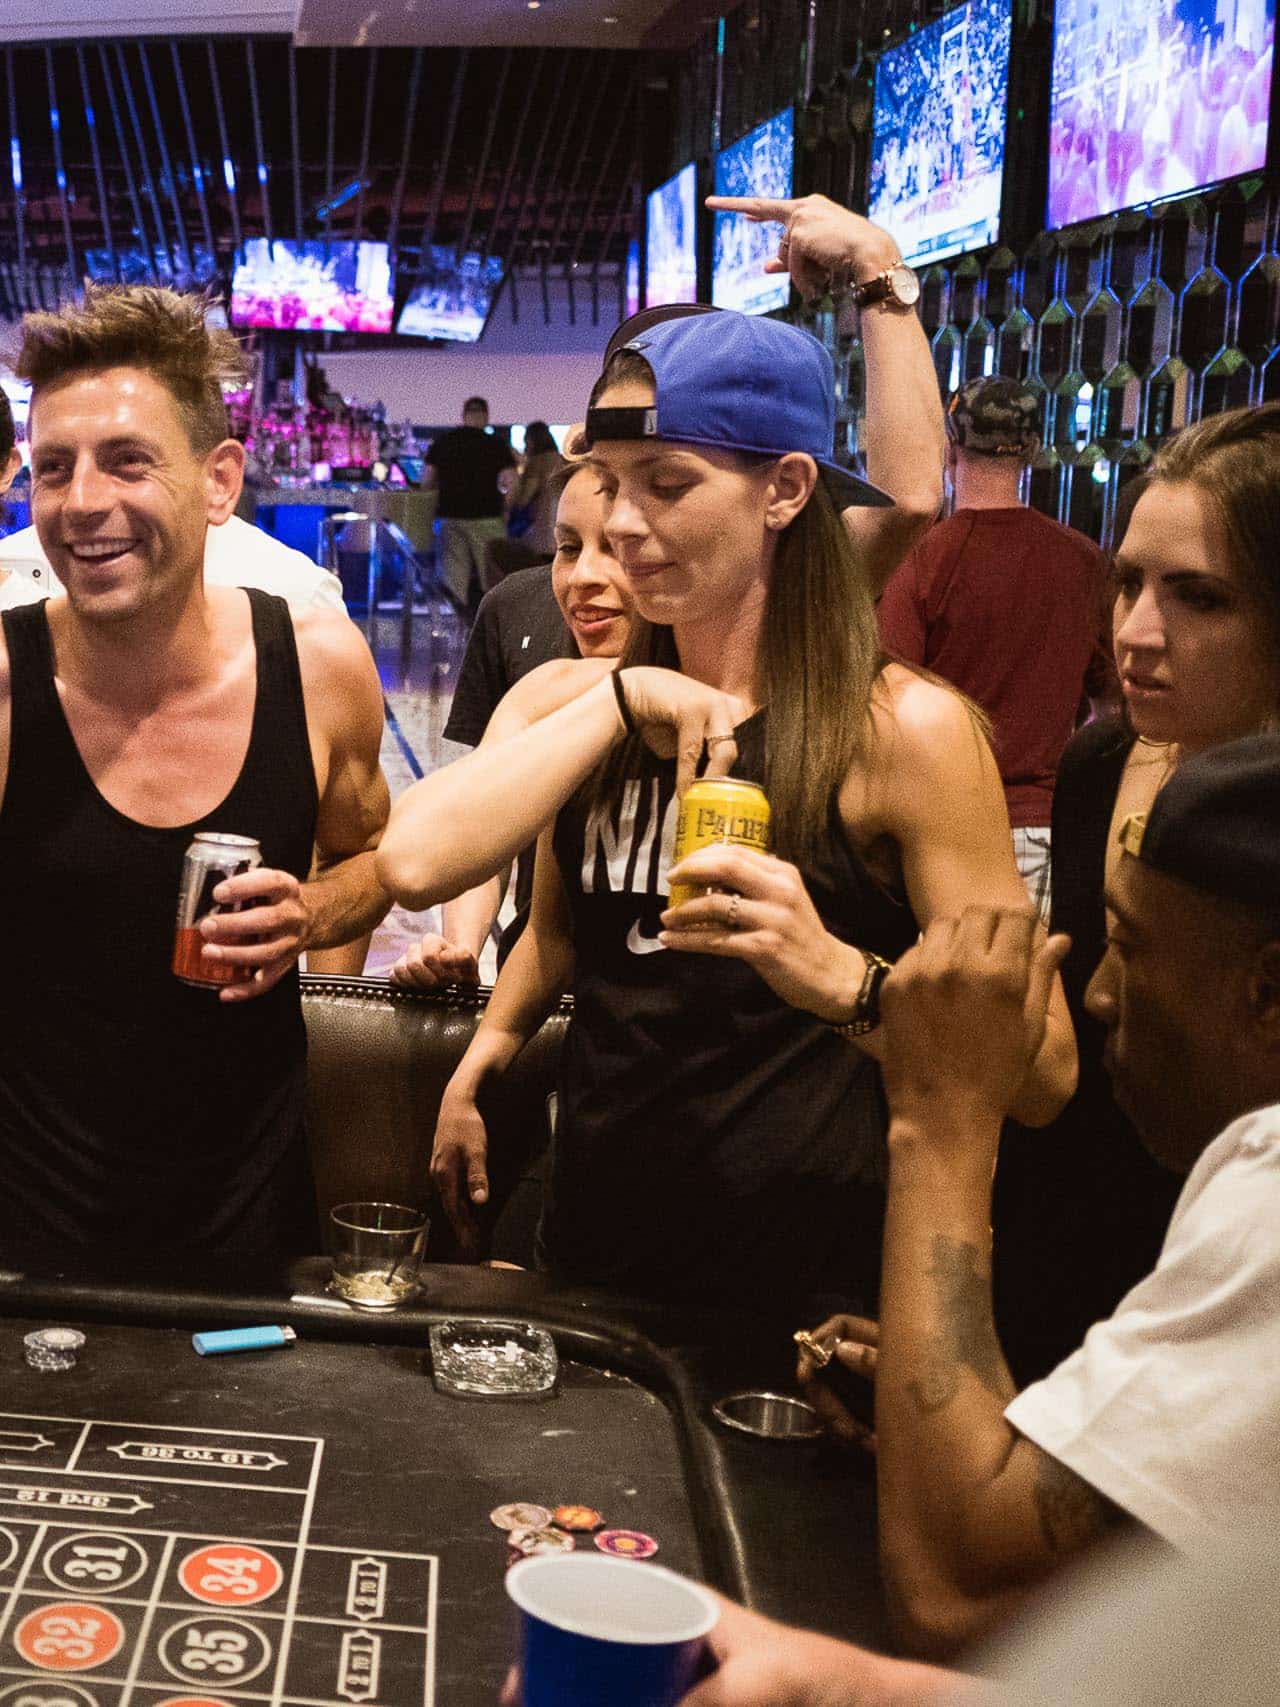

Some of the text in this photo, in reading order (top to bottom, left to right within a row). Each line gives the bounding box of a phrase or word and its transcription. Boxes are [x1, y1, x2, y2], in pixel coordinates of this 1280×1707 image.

[142, 1447, 255, 1465] 19 TO 36
[16, 1489, 110, 1508] 3rd 12
[64, 1546, 128, 1581] 31
[200, 1557, 262, 1595] 34
[354, 1596, 377, 1607] 2
[32, 1616, 101, 1659] 32
[181, 1628, 248, 1674] 35
[346, 1674, 369, 1686] 2
